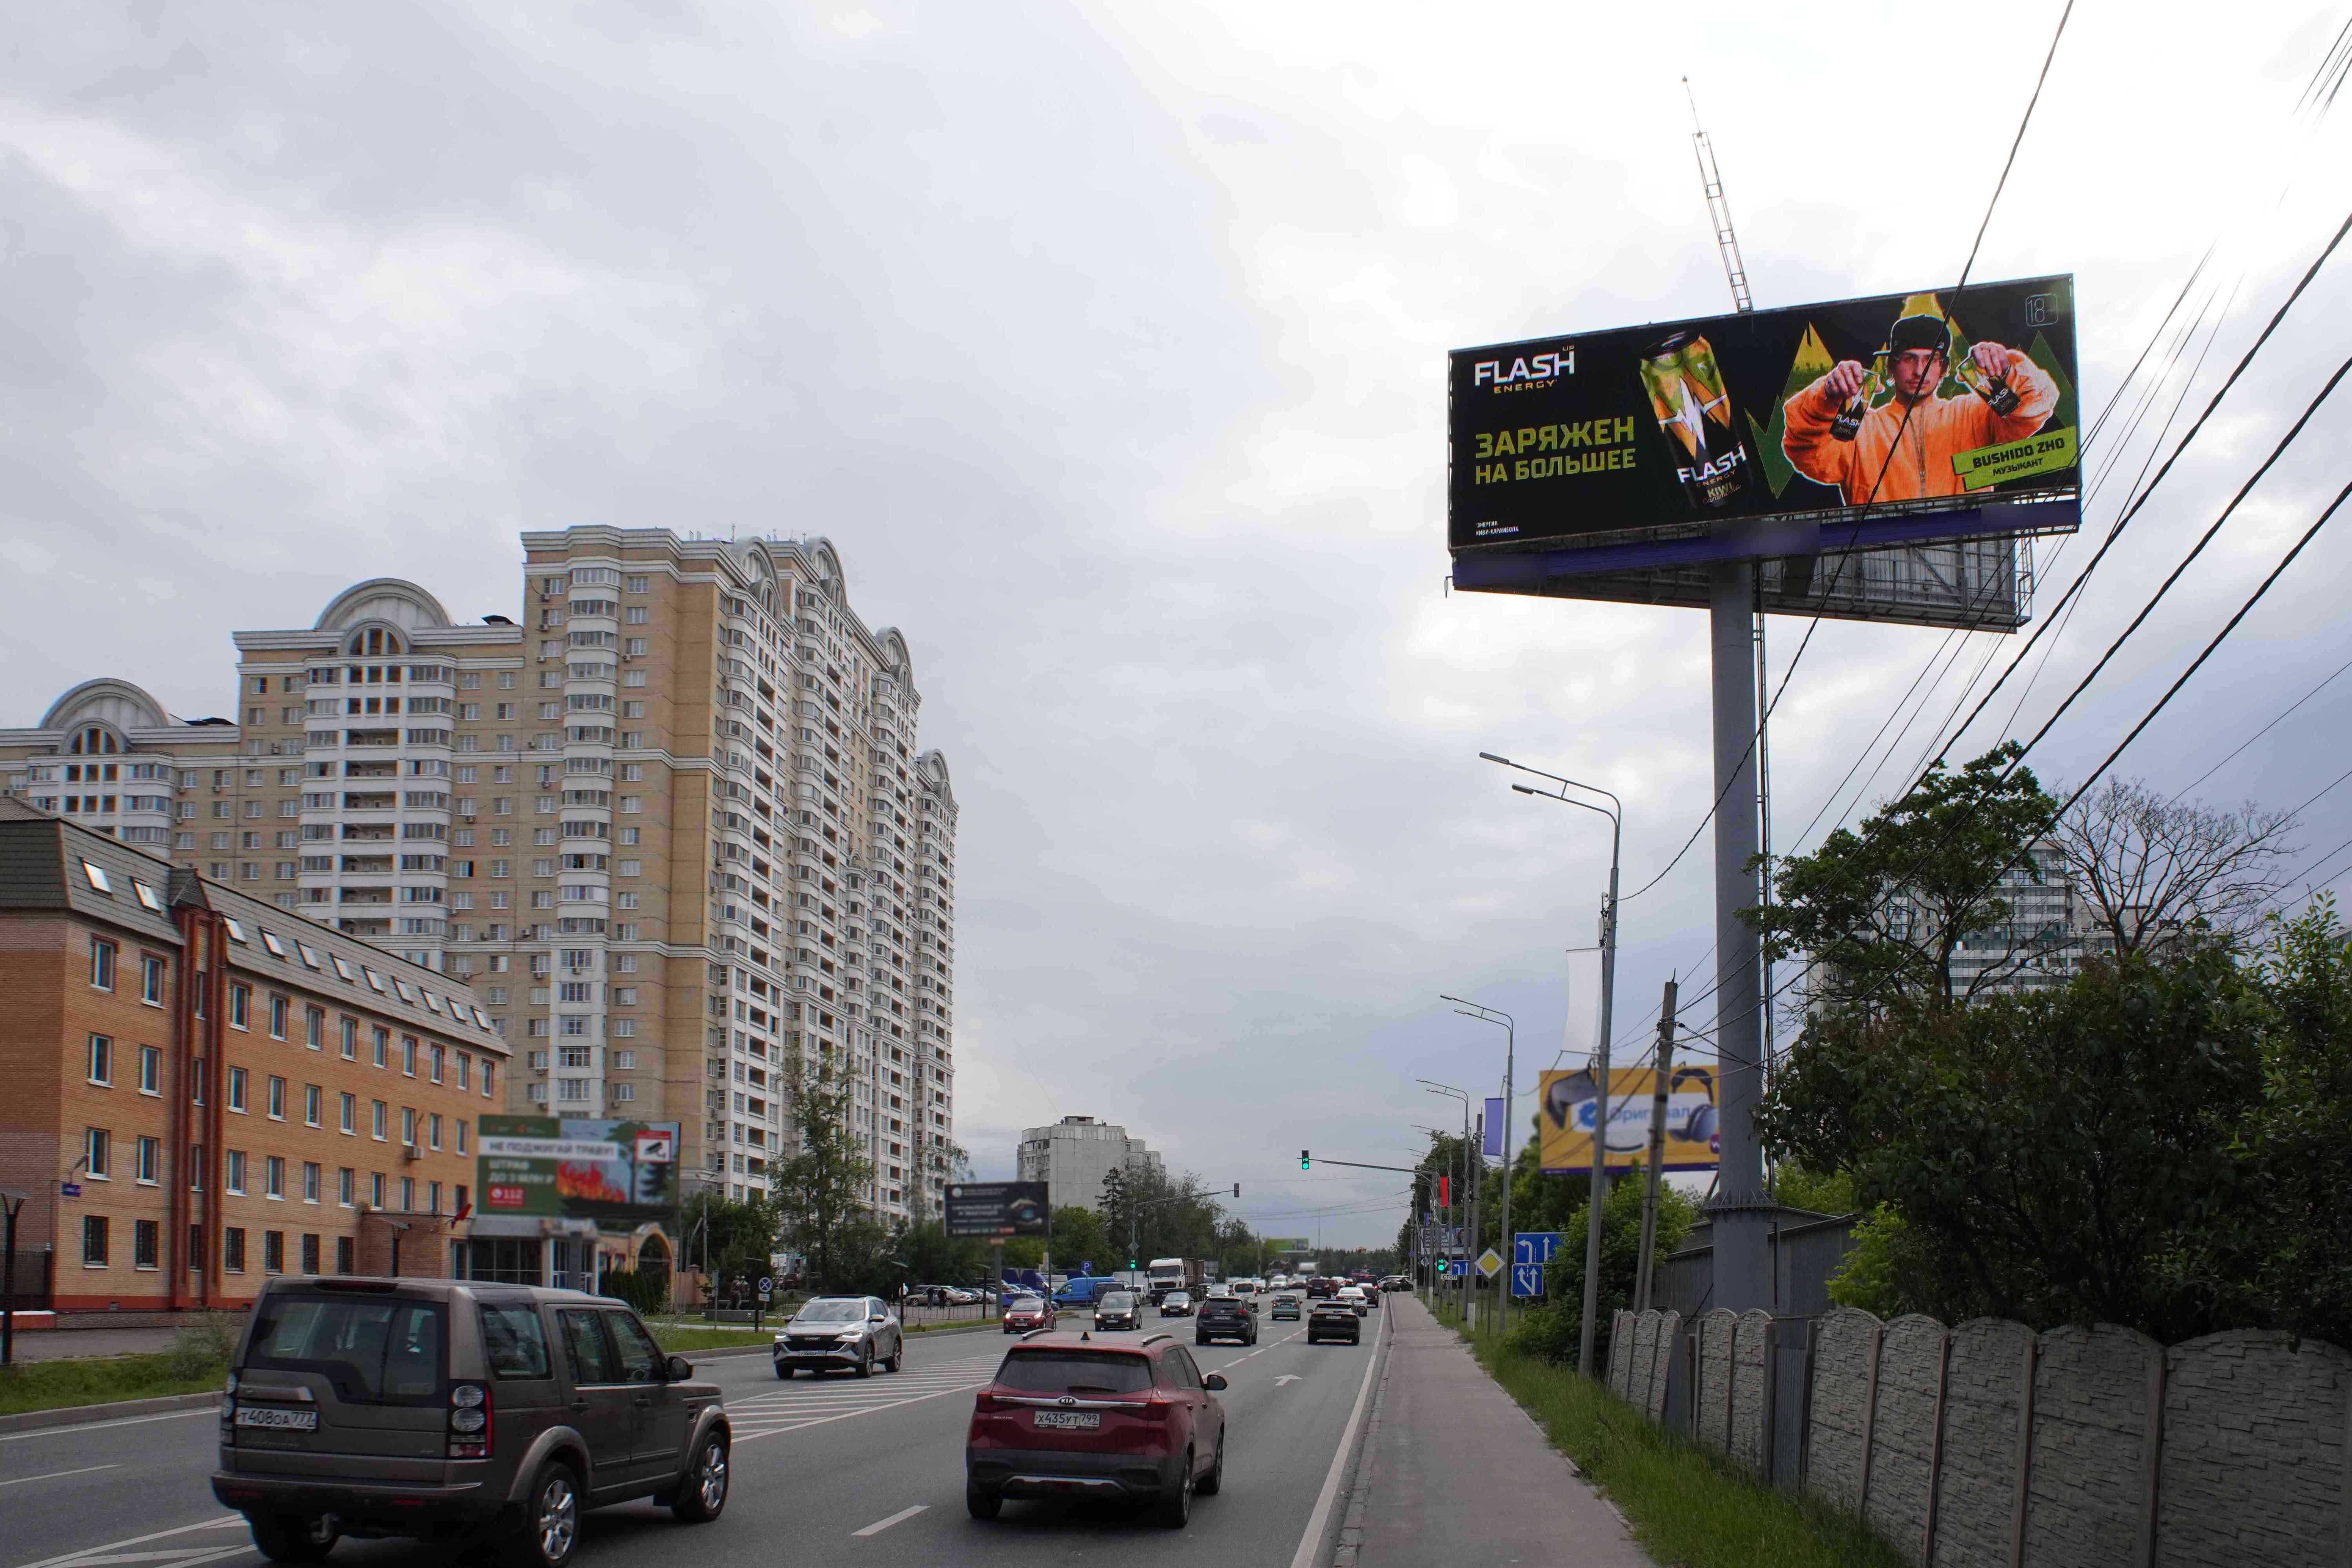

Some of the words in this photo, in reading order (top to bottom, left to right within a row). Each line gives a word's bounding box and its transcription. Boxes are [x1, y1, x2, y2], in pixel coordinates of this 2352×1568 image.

[1475, 350, 1575, 387] FLASH
[1475, 416, 1634, 459] ЗАРЯЖЕН
[1677, 445, 1747, 483] FLASH
[1973, 445, 2034, 468] BUSHIDO
[2036, 437, 2065, 453] ZHO
[1475, 463, 1508, 485] НА
[1515, 448, 1636, 480] БОЛЬШЕЕ
[1993, 458, 2043, 475] МУЗЫКАНТ
[1609, 1106, 1690, 1122] Оригал
[490, 1141, 504, 1151] НЕ
[506, 1140, 573, 1154] ПОДЖИГАЙ
[503, 1188, 524, 1199] 112
[1081, 1414, 1097, 1423] 799
